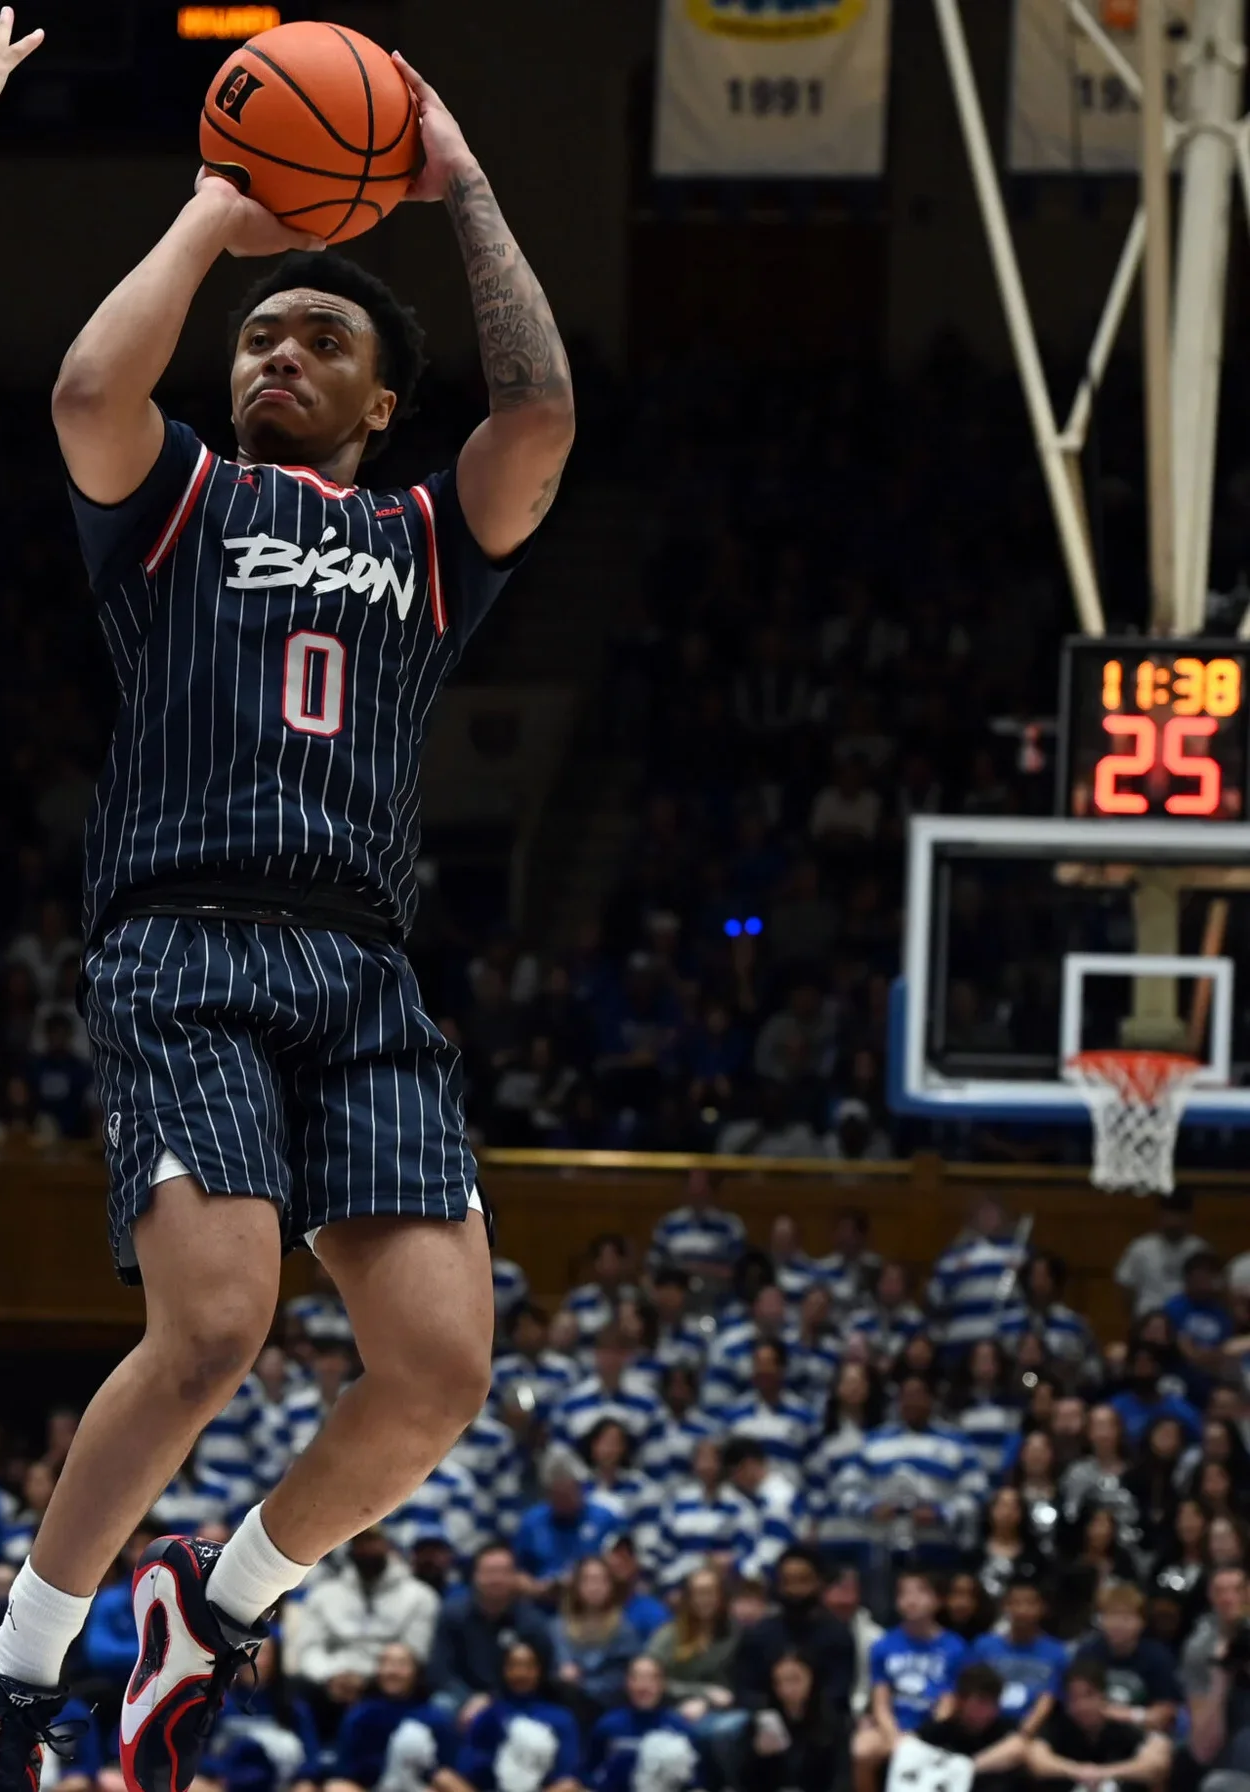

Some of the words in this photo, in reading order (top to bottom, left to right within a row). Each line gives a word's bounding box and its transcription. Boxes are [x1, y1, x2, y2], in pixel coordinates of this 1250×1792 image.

[727, 76, 823, 115] 1991
[282, 629, 347, 737] 0
[1102, 657, 1241, 717] 11:38
[1094, 714, 1221, 815] 25
